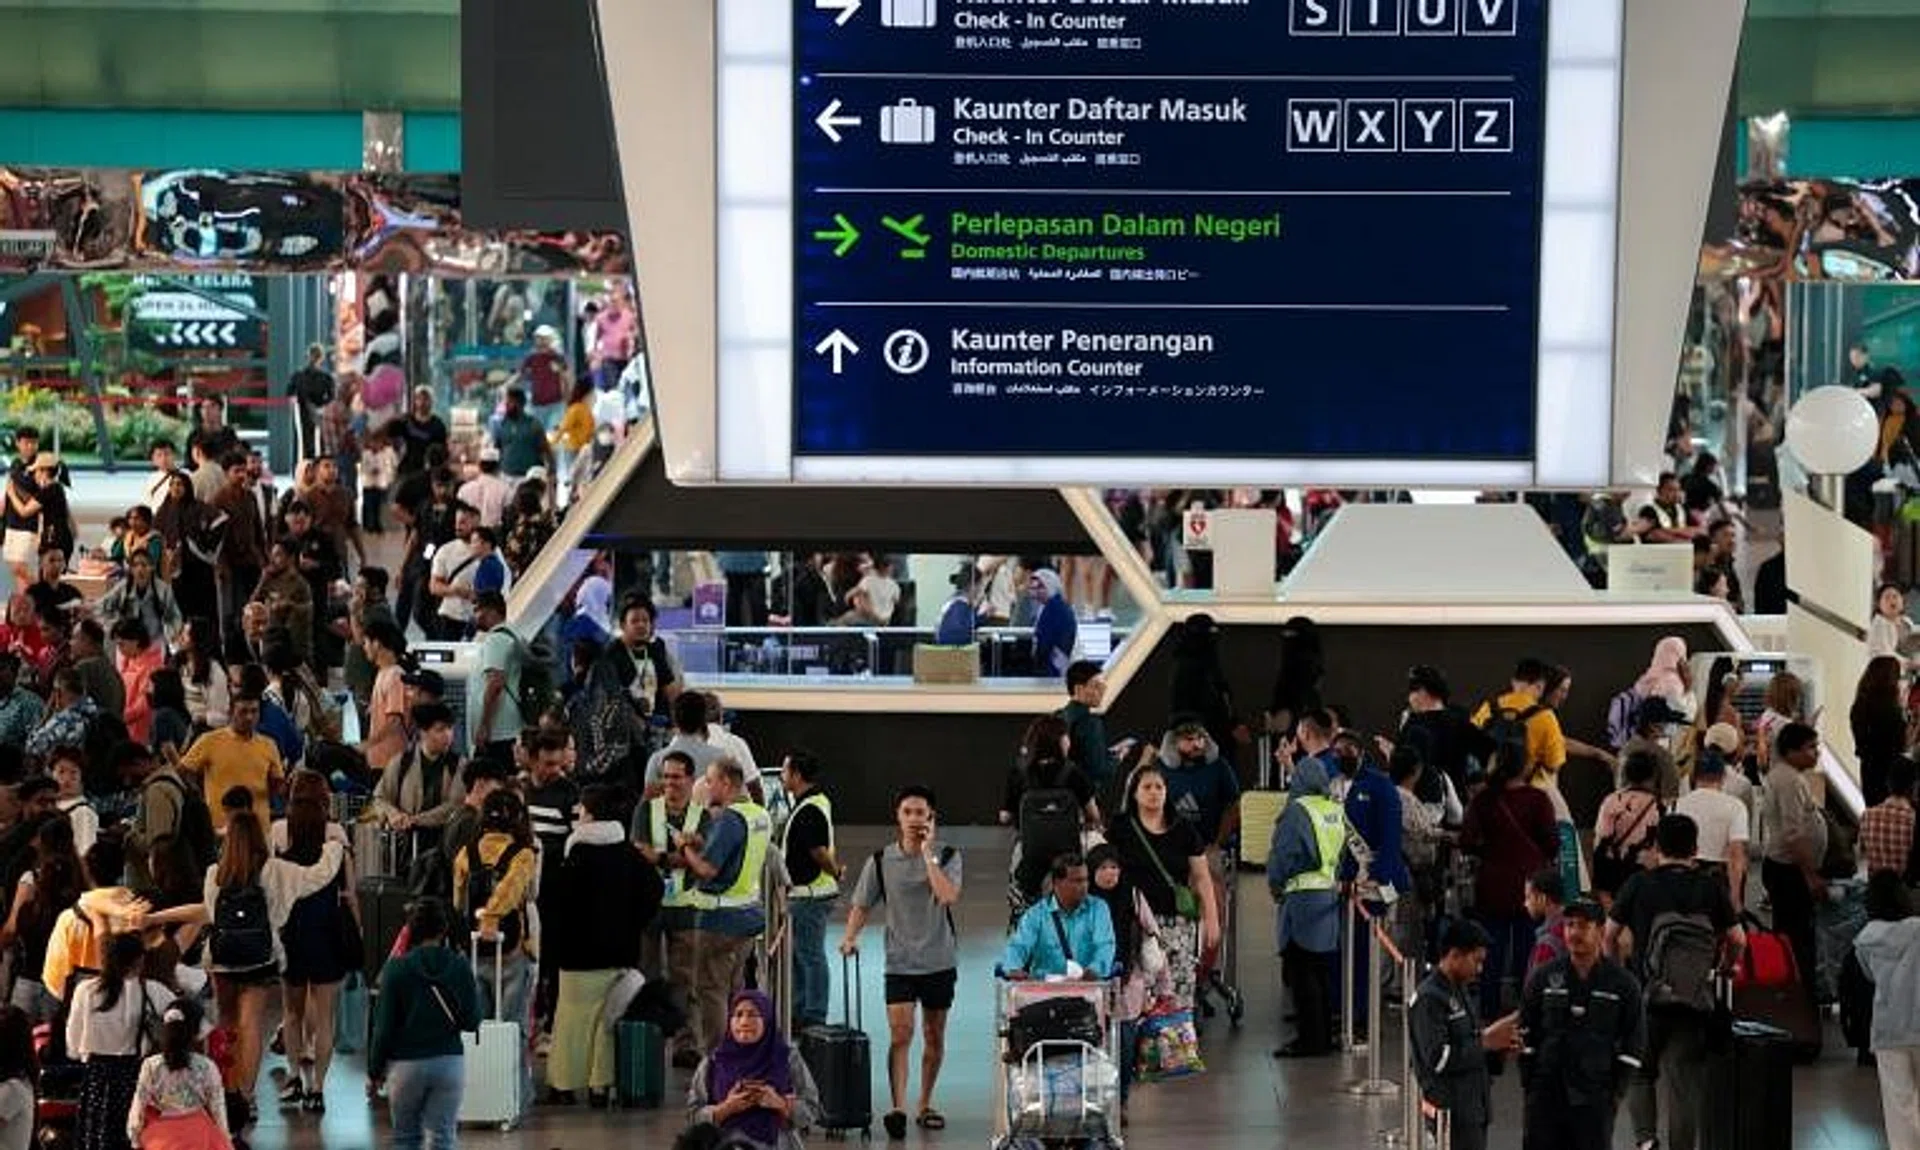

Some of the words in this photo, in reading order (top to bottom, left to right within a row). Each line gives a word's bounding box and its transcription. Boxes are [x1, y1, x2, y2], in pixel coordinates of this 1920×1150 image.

[953, 11, 1010, 29] Check
[1026, 12, 1045, 29] In
[1049, 12, 1127, 29] Counter
[1305, 0, 1328, 26] S
[1417, 0, 1446, 26] U
[1477, 0, 1504, 26] V
[954, 96, 1060, 120] Kaunter
[1068, 96, 1153, 121] Daftar
[1160, 97, 1247, 122] Masuk
[953, 127, 1009, 145] Check
[1026, 128, 1044, 145] In
[1048, 128, 1125, 146] Counter
[1292, 109, 1337, 142] W
[1356, 109, 1386, 143] X
[1414, 110, 1443, 143] Y
[1474, 110, 1499, 143] Z
[952, 212, 1093, 240] Perlepasan
[1103, 212, 1184, 236] Dalam
[1194, 213, 1280, 241] Negeri
[951, 242, 1037, 259] Domestic
[1042, 243, 1145, 263] Departures
[952, 328, 1055, 352] Kaunter
[1062, 329, 1214, 357] Penerangan
[951, 357, 1062, 376] Information
[1066, 358, 1144, 377] Counter
